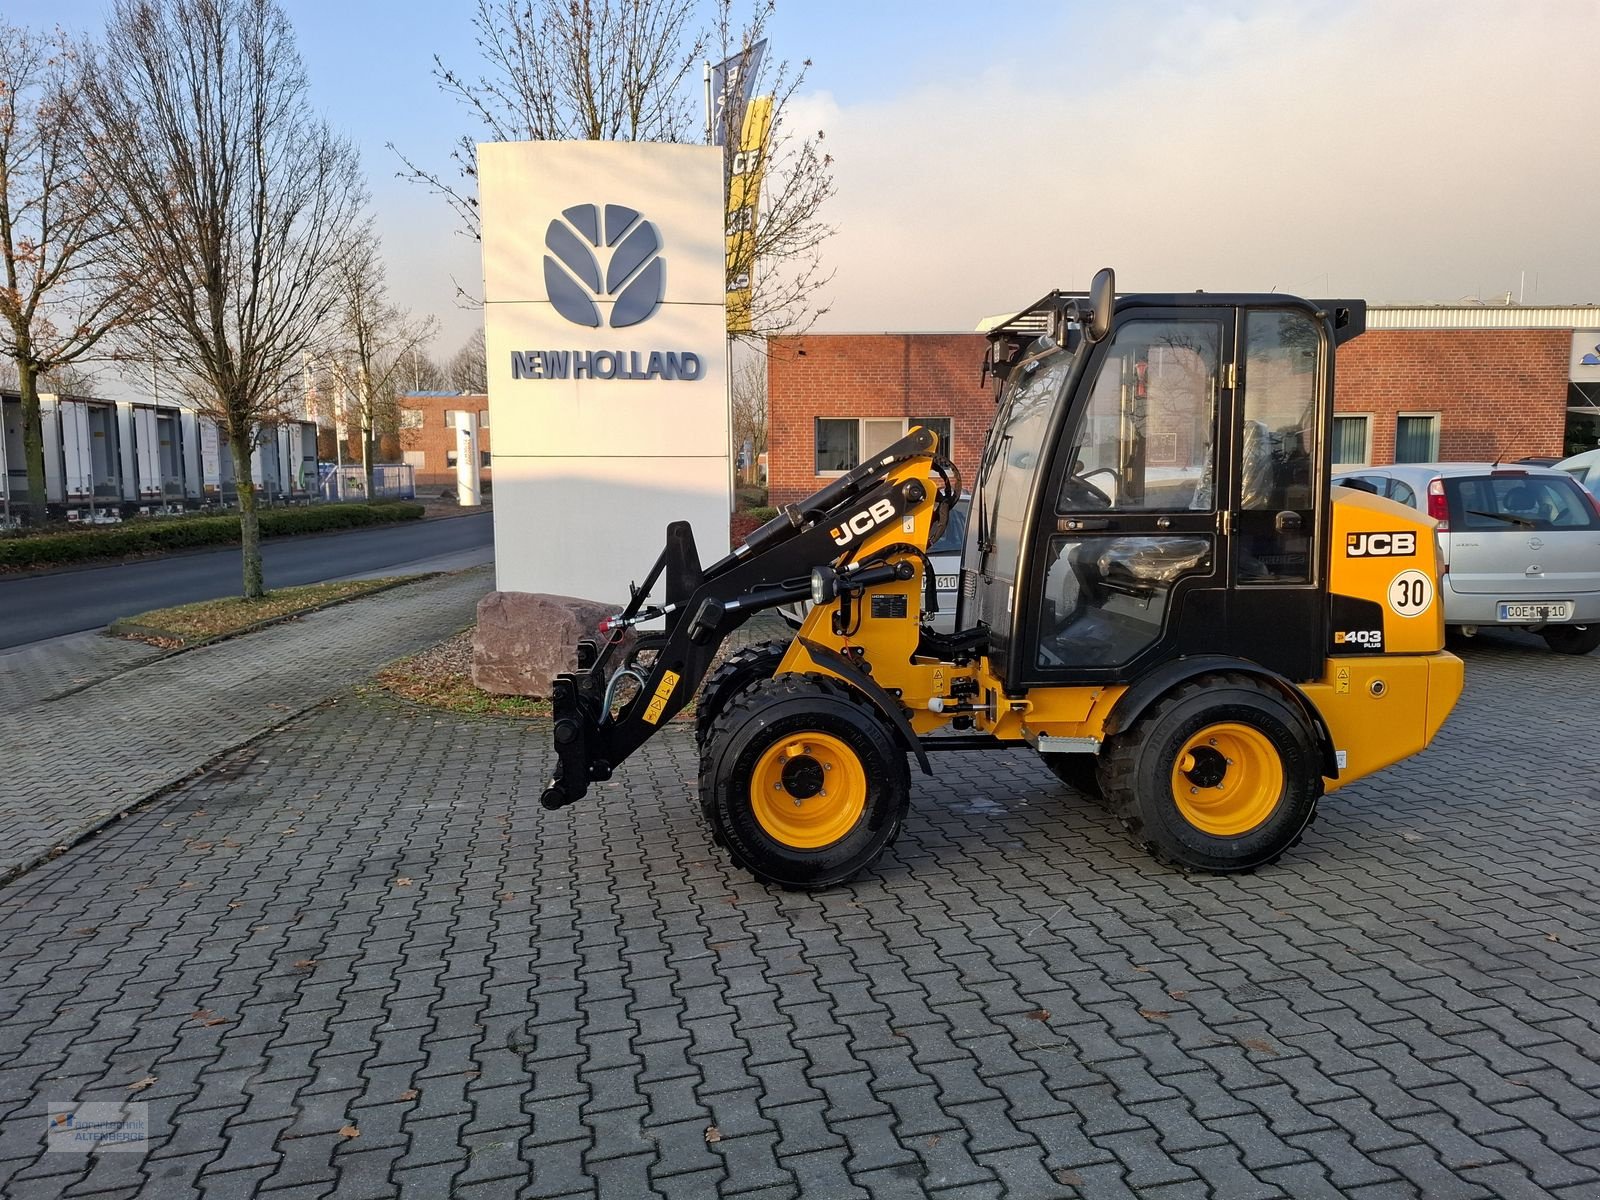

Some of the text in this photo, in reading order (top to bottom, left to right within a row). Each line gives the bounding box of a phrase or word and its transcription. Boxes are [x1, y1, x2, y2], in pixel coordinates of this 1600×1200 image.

[511, 350, 701, 381] NEW HOLLAND
[832, 498, 896, 546] JCB
[1347, 533, 1415, 555] JCB
[1397, 579, 1424, 607] 30
[1508, 606, 1529, 617] COE
[1345, 631, 1382, 643] 403
